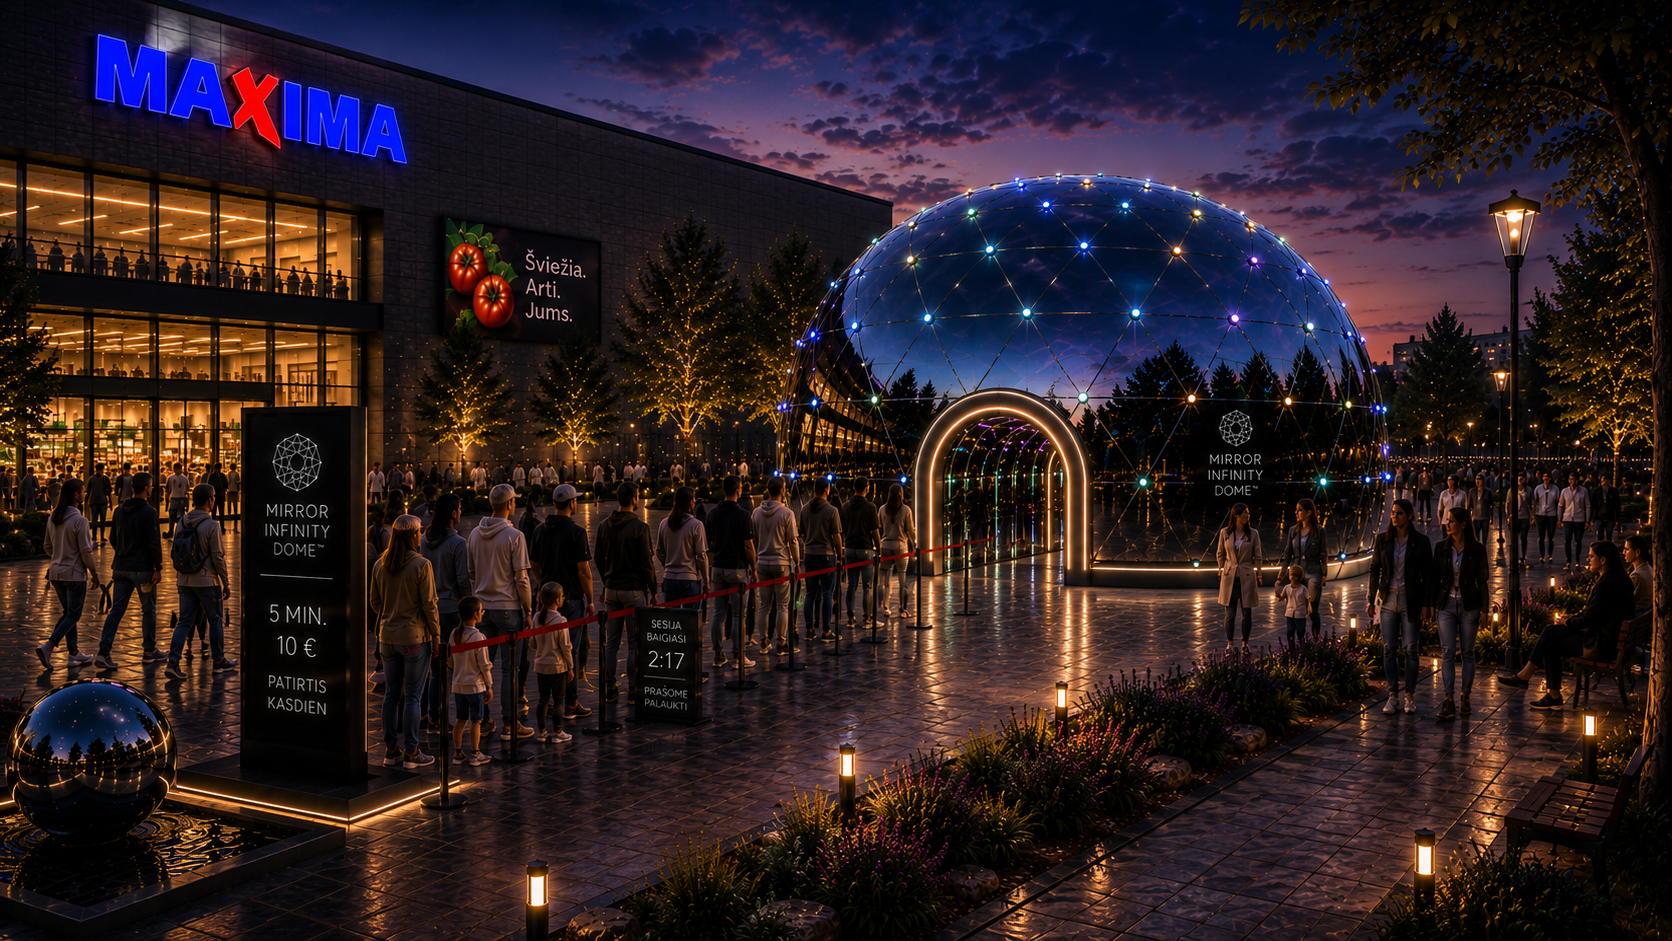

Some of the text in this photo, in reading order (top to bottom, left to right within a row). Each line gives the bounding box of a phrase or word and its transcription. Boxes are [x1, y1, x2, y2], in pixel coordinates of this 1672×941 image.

[95, 33, 408, 165] MAXIMA
[525, 248, 586, 279] Šviežia.
[525, 278, 561, 299] Arti.
[525, 301, 573, 322] Jums.
[1209, 453, 1262, 465] MIRROR
[1208, 469, 1263, 481] INFINITY
[266, 503, 329, 519] MIRROR
[264, 523, 331, 539] INFINITY
[269, 603, 327, 626] 5 MIN.
[651, 619, 682, 630] SESIJA
[277, 635, 317, 658] 10 €
[646, 632, 687, 644] BAIGIASI
[648, 650, 685, 670] 2:17
[268, 674, 327, 694] PATIRTIS
[267, 696, 327, 716] KASDIEN
[644, 698, 688, 711] PALAUKTI
